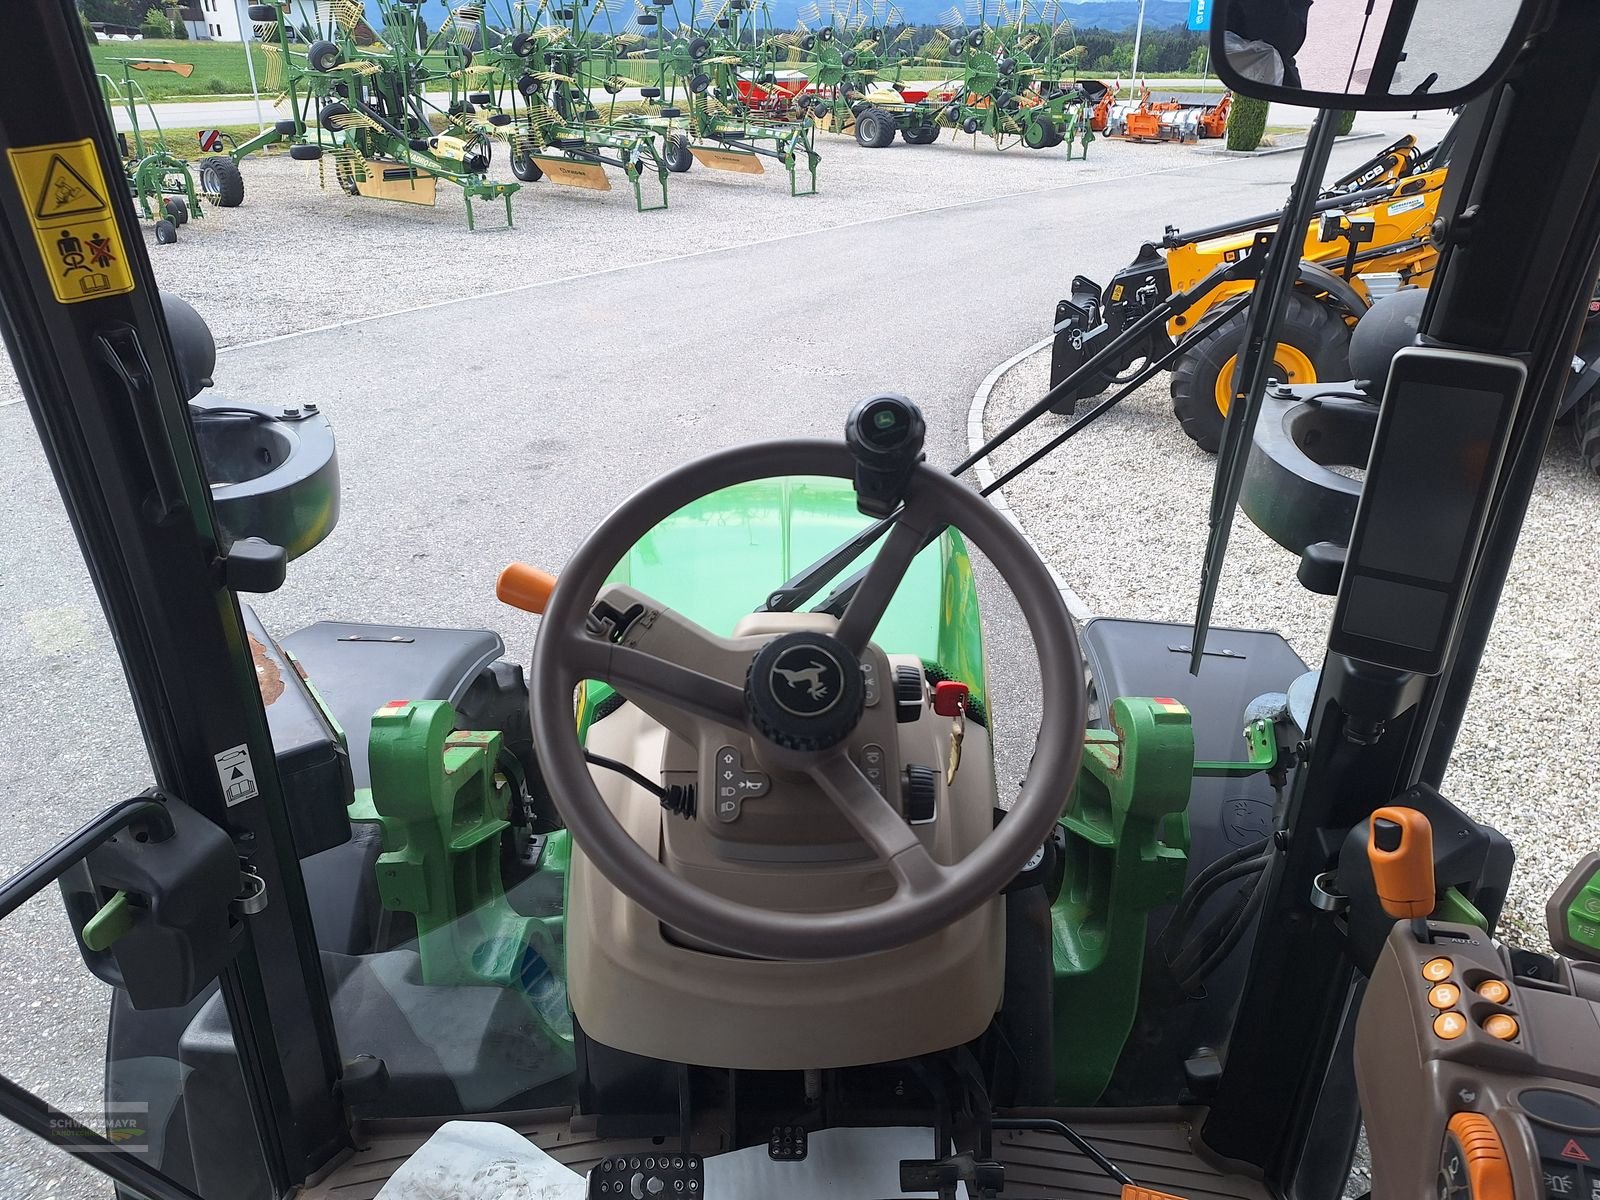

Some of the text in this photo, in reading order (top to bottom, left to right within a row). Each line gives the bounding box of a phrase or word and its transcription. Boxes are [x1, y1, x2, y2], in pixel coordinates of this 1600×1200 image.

[1357, 165, 1385, 186] JCB
[1451, 938, 1480, 946] AUTO
[1431, 963, 1444, 975] C
[1436, 988, 1451, 1002] B
[1443, 1016, 1459, 1032] A
